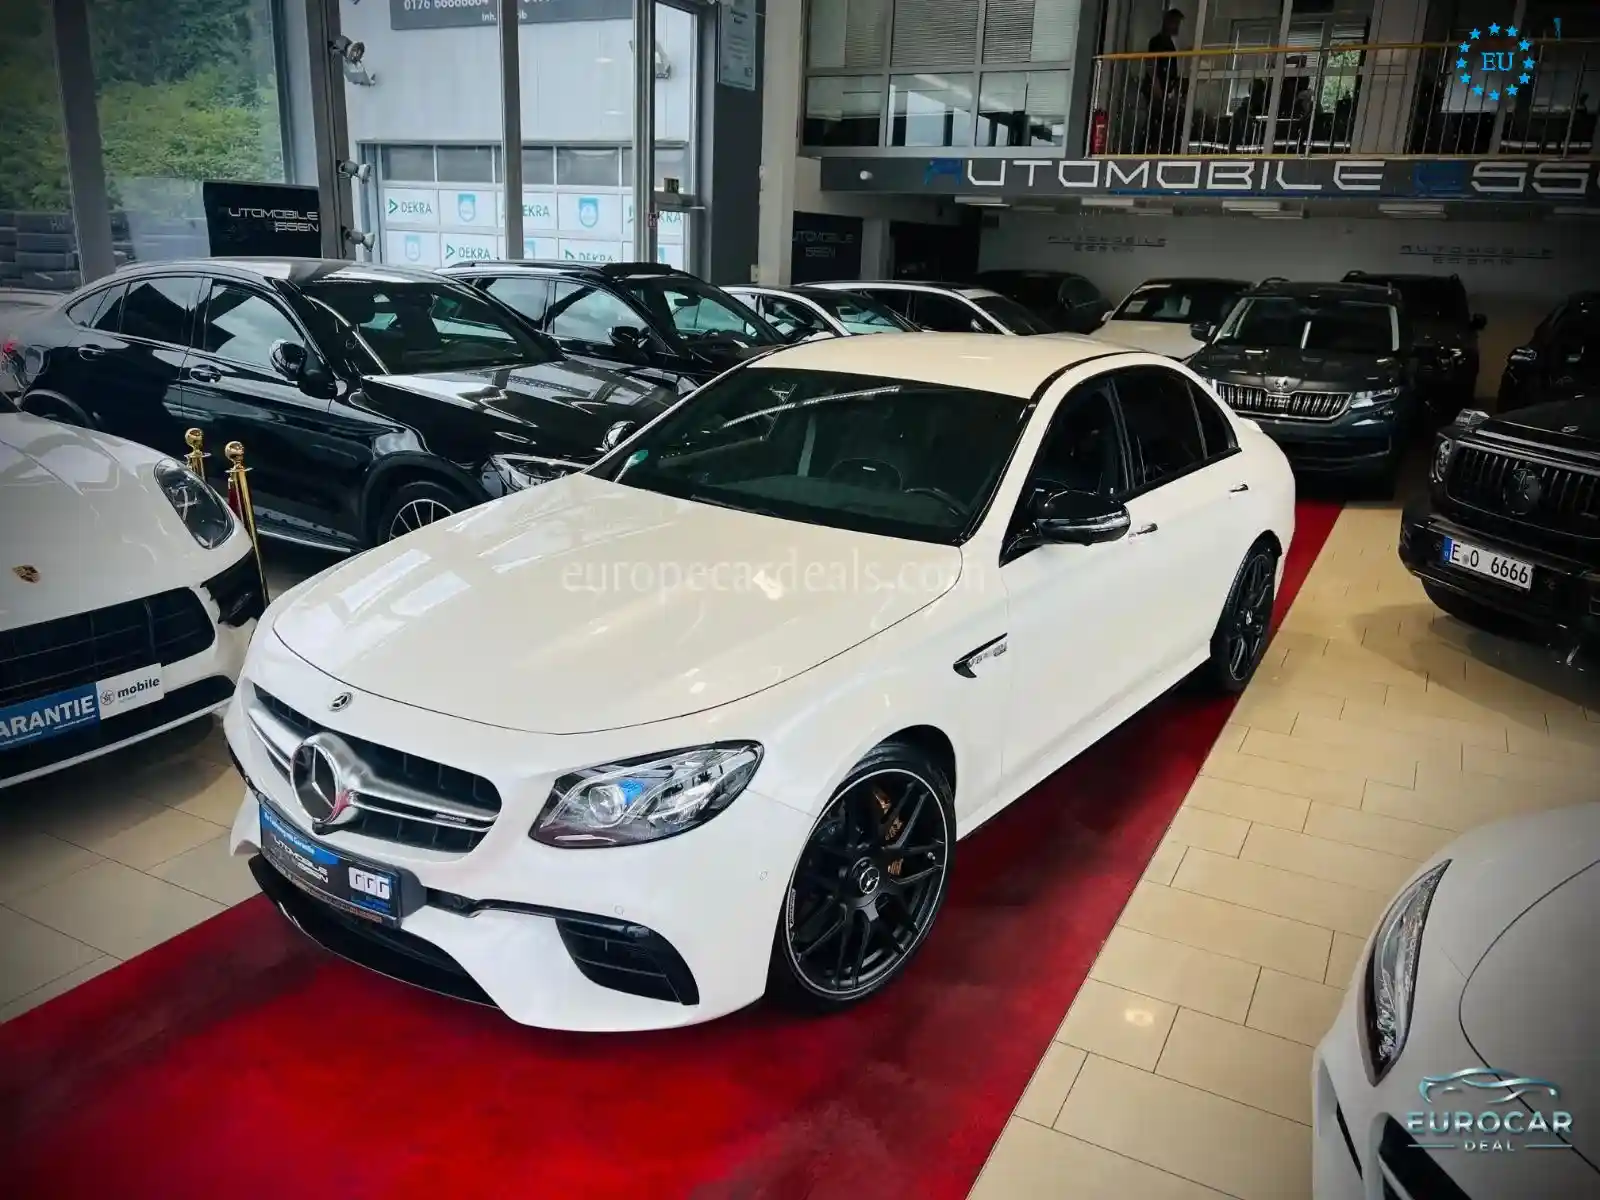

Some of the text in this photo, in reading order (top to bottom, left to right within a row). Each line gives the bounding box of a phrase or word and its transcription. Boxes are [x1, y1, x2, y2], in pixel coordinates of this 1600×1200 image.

[924, 159, 1600, 194] AUTOMOBILE ESS
[228, 207, 319, 220] UTOMOBILE
[401, 202, 432, 214] DEKRA
[522, 204, 550, 217] EKRA
[275, 221, 319, 232] SSEN
[459, 246, 491, 260] DEKRA
[1450, 542, 1461, 562] E
[1490, 556, 1529, 584] 6666
[117, 677, 160, 699] mobile
[0, 694, 96, 739] ARANTIE
